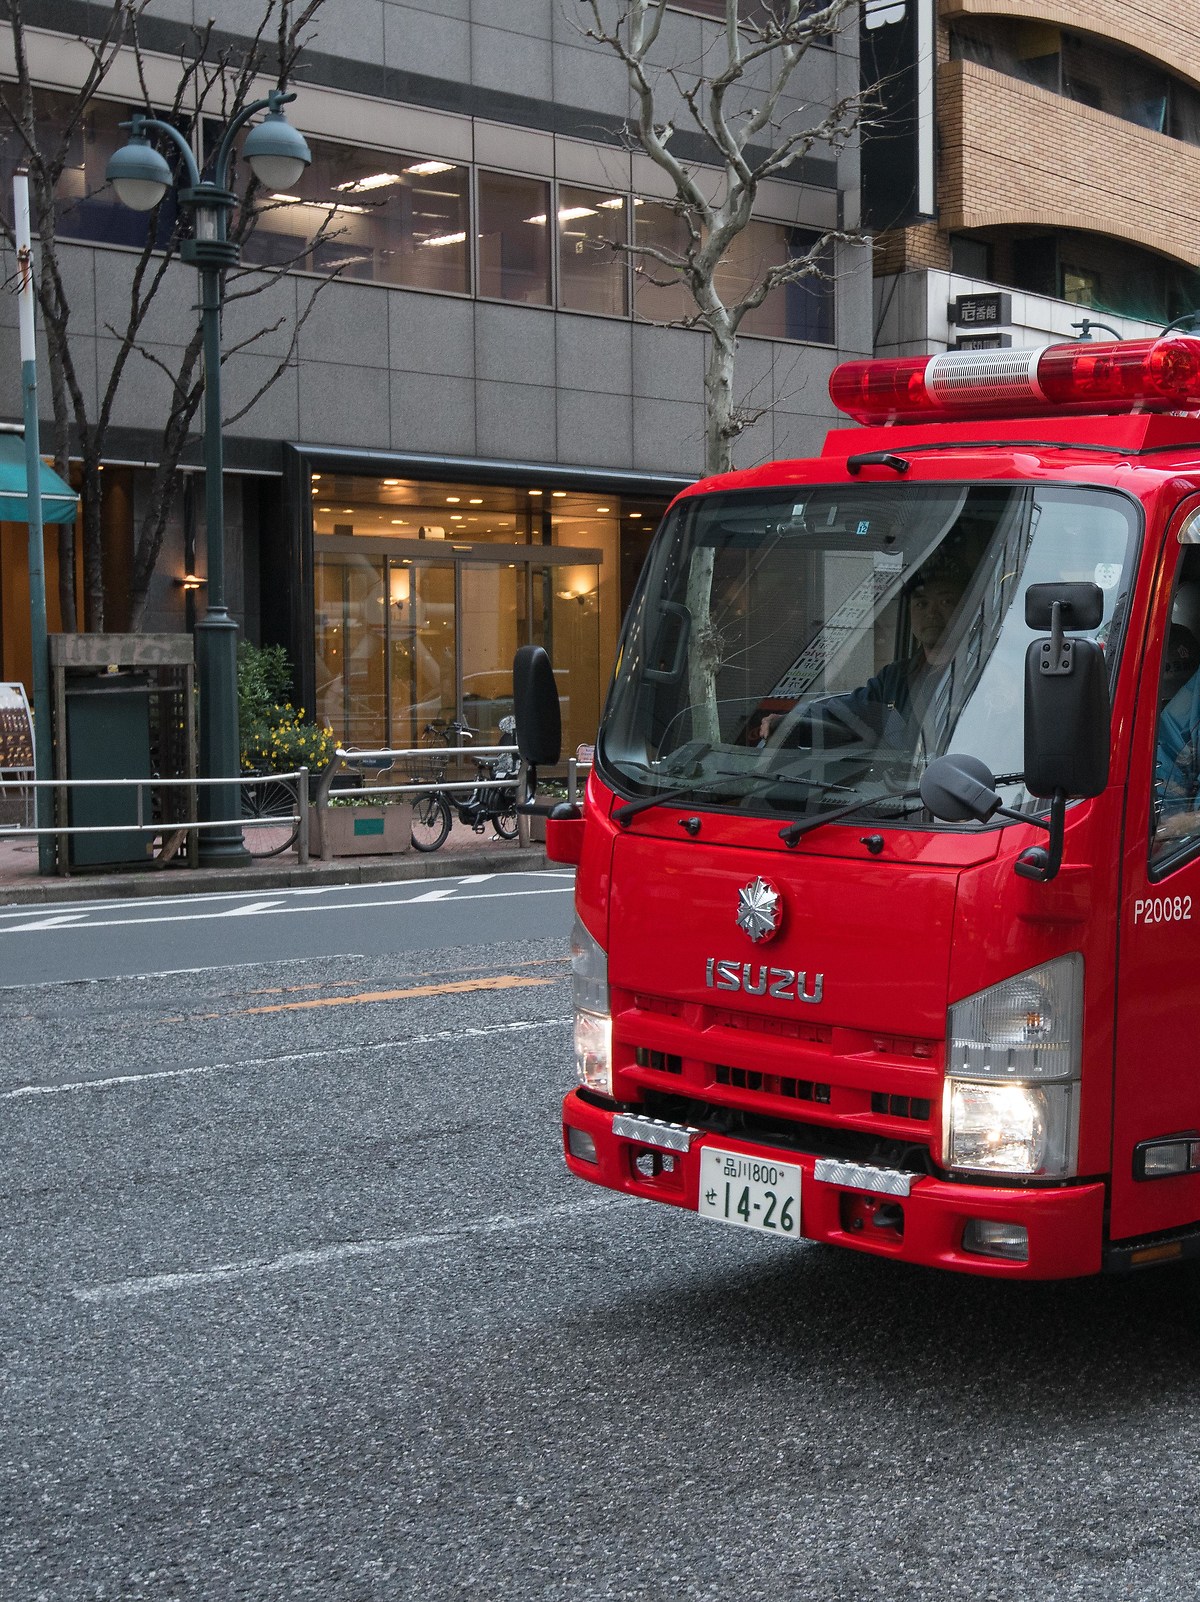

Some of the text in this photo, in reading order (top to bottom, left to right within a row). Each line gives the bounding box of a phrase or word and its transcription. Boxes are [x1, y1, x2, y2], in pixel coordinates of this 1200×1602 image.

[1133, 895, 1193, 925] P20082
[705, 957, 824, 1004] ISUZU
[724, 1158, 777, 1185] 品川800
[725, 1182, 795, 1232] 14-26
